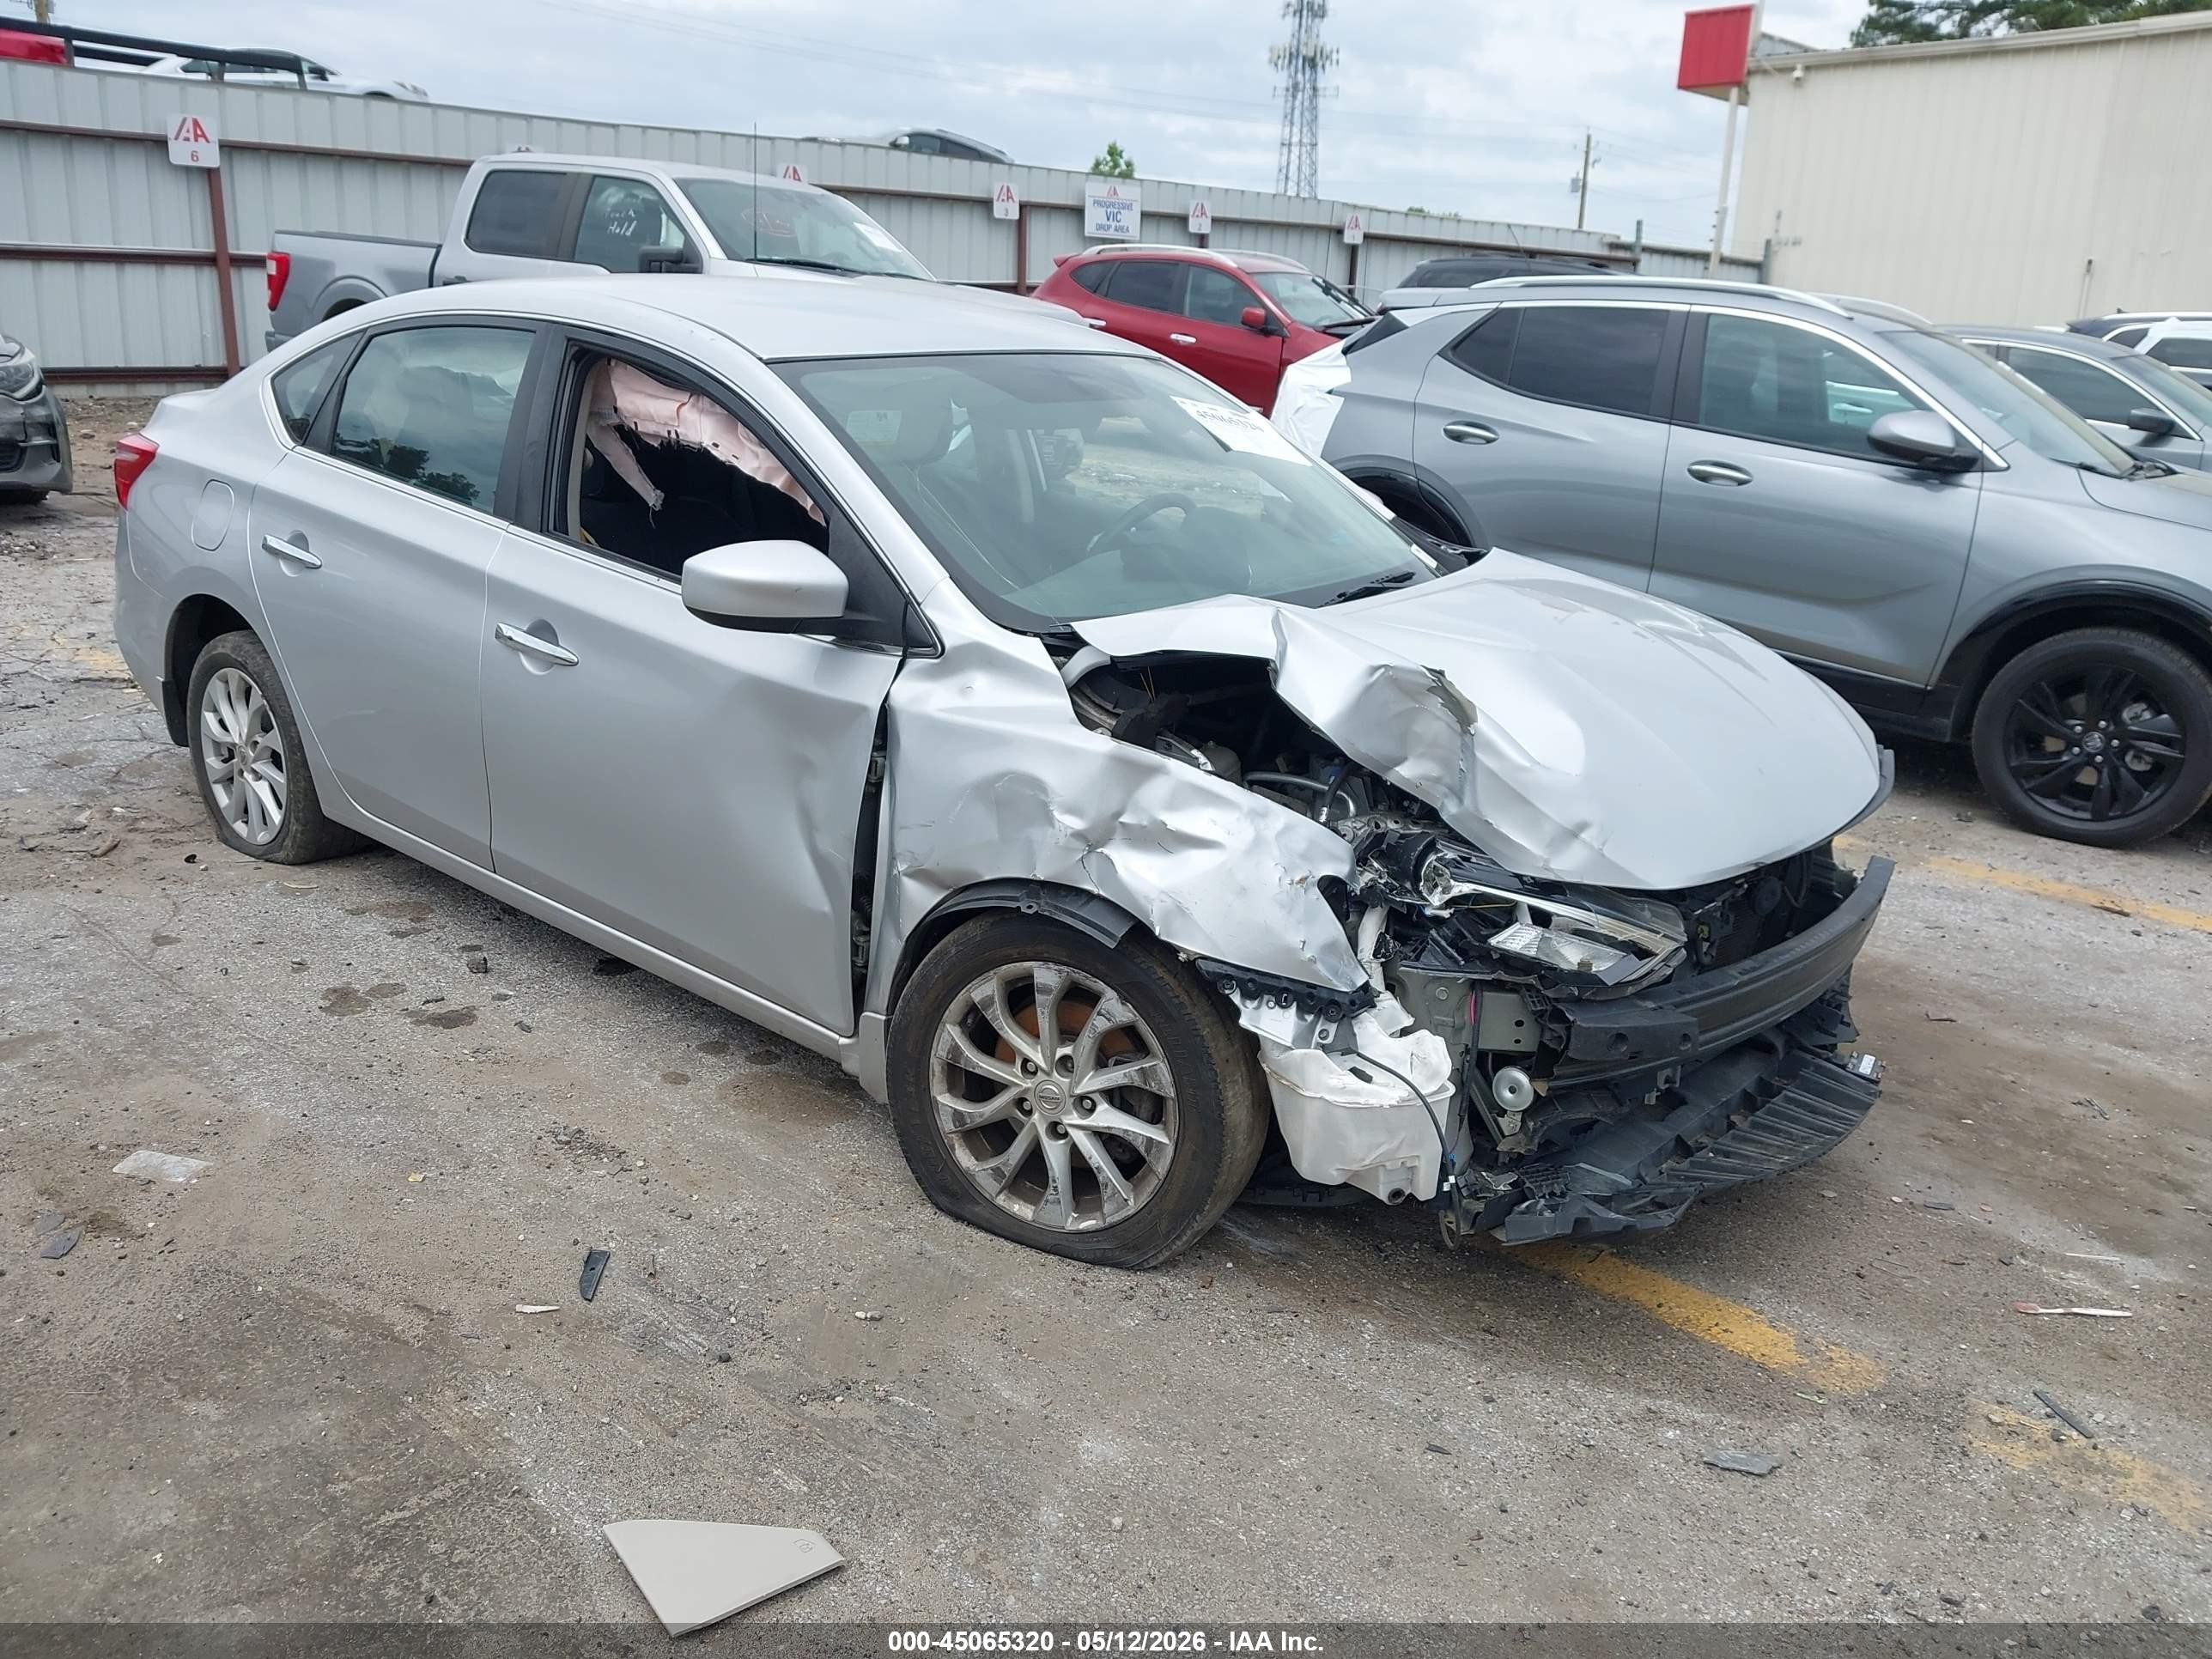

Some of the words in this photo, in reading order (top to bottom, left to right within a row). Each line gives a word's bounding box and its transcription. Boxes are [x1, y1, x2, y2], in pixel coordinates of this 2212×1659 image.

[191, 150, 199, 162] 6
[1092, 199, 1133, 211] PROGRESSIVE
[1105, 210, 1122, 222] VIC
[1095, 223, 1112, 233] DROP
[1114, 224, 1130, 234] AREA
